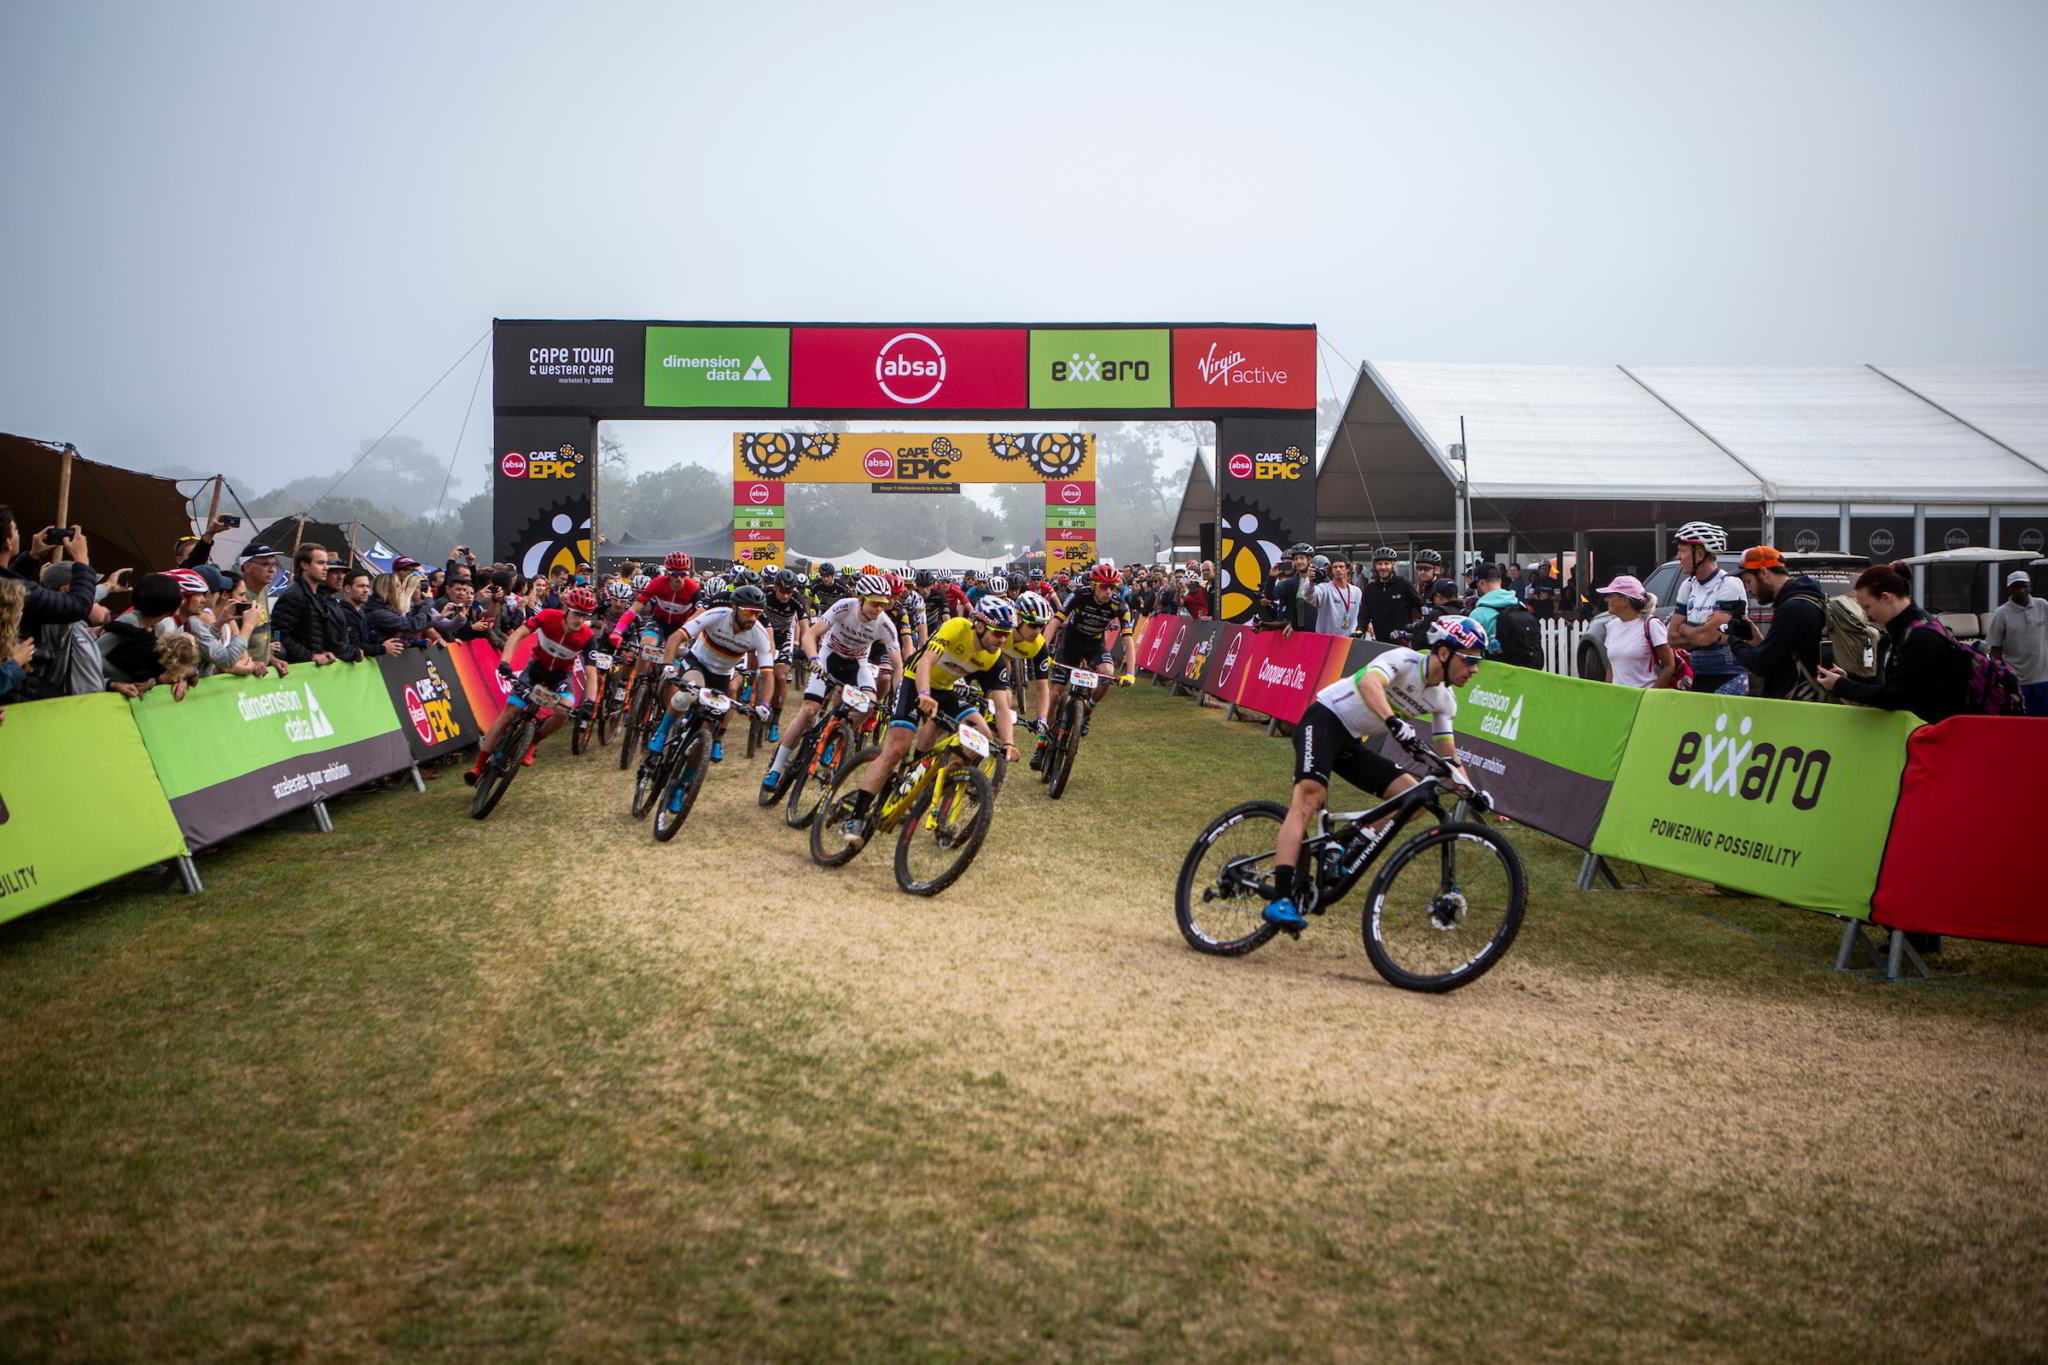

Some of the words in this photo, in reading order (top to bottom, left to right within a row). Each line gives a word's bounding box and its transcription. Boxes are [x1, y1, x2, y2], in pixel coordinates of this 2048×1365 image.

[529, 348, 569, 364] CAPE
[572, 348, 614, 364] TOWN
[663, 354, 741, 368] dimension
[884, 353, 938, 376] absa
[1198, 342, 1245, 386] Virgin
[529, 365, 537, 376] &
[588, 365, 614, 376] CAPE
[706, 368, 741, 382] data
[1052, 353, 1150, 382] exxaro
[1232, 367, 1288, 384] active
[584, 377, 591, 385] by
[529, 451, 558, 461] CAPE
[897, 447, 929, 458] CAPE
[1255, 452, 1283, 462] CAPE
[505, 460, 524, 468] absa
[529, 461, 577, 479] EPIC
[867, 458, 890, 467] absa
[897, 459, 952, 479] EPIC
[1231, 461, 1250, 469] absa
[1255, 462, 1301, 479] EPIC
[752, 489, 768, 497] absa
[1063, 489, 1079, 497] absa
[1798, 536, 1817, 545] absa
[1872, 536, 1891, 545] absa
[753, 552, 775, 560] EPIC
[1066, 552, 1088, 560] EPIC
[1258, 657, 1285, 688] Conquer
[1282, 671, 1294, 686] as
[416, 678, 437, 701] CAPE
[1468, 684, 1510, 712] dimension
[238, 684, 302, 721] dimension
[285, 714, 313, 742] data
[424, 700, 461, 743] EPIC
[1481, 711, 1502, 735] data
[1304, 724, 1315, 773] cannondale
[1668, 713, 1831, 811] exxaro
[272, 774, 308, 800] accelerate
[307, 769, 324, 791] your
[322, 761, 351, 784] ambition
[1650, 818, 1713, 848] POWERING
[1714, 833, 1802, 868] POSSIBILITY
